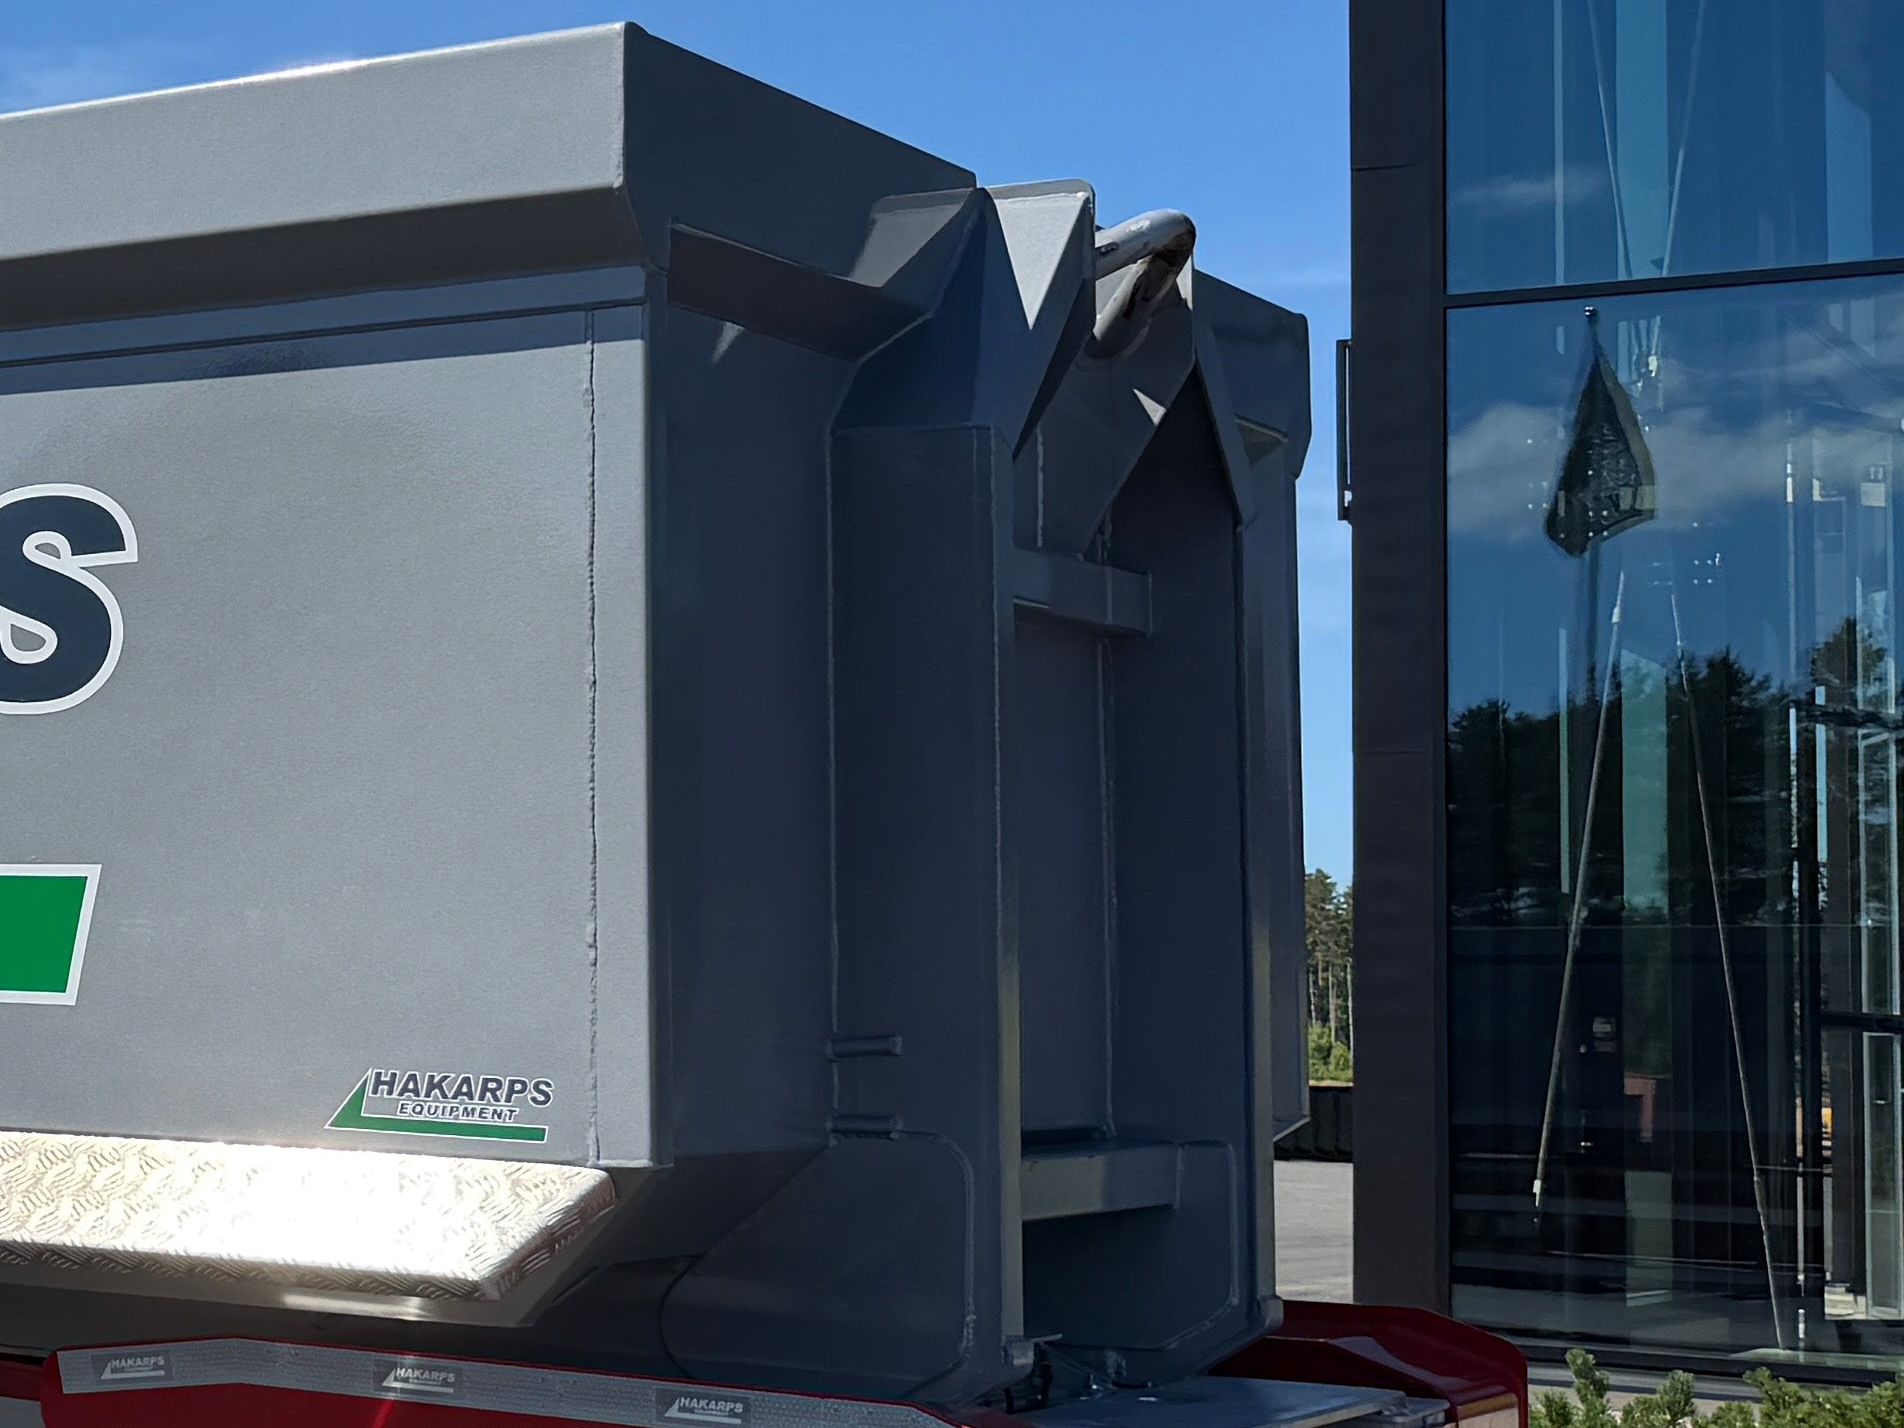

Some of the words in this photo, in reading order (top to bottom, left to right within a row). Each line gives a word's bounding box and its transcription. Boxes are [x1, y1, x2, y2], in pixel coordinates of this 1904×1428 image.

[369, 1069, 555, 1107] HAKARPS
[397, 1100, 520, 1123] EQUIPMENT
[680, 1396, 744, 1413] HAKARPS
